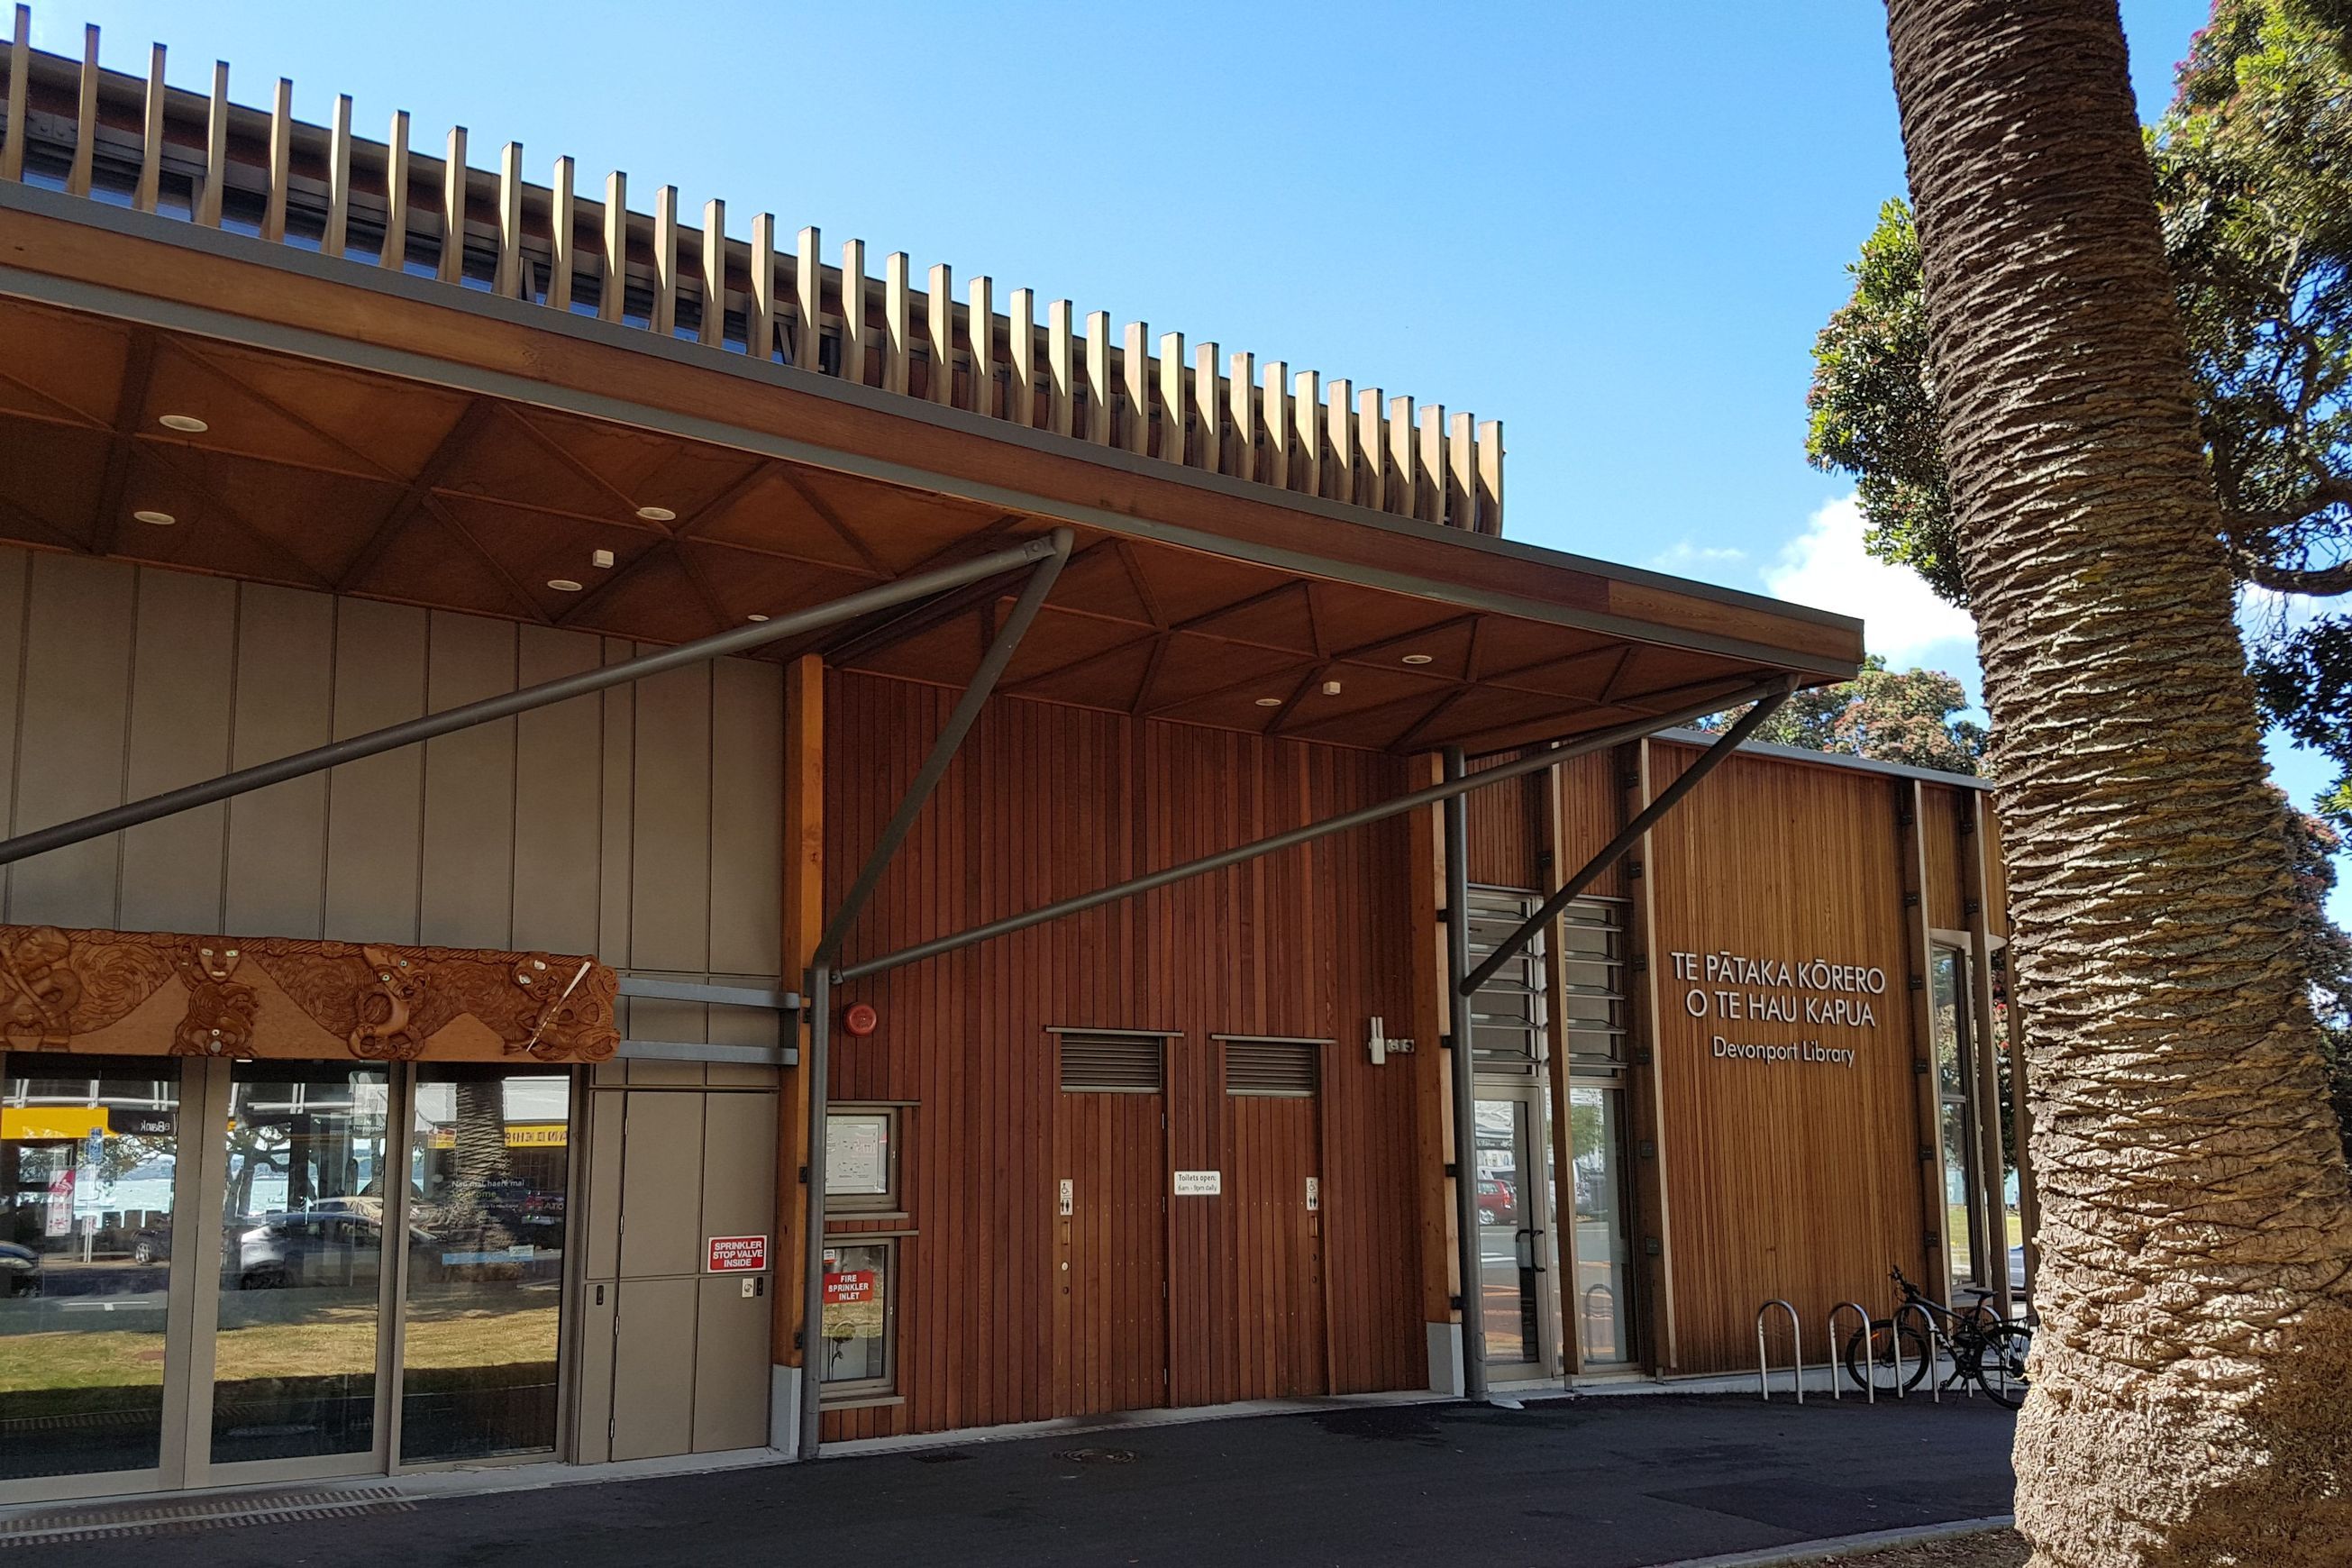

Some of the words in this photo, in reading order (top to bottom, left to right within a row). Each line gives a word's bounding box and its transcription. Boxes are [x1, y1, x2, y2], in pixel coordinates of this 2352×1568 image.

[1671, 952, 1698, 981] TE
[1706, 952, 1792, 988] PĀTAKA
[1798, 959, 1886, 994] KŌRERO
[1686, 989, 1708, 1017] O
[1714, 991, 1741, 1019] TE
[1748, 993, 1797, 1023] HAU
[1805, 997, 1875, 1027] KAPUA
[1713, 1036, 1799, 1064] Devonport
[1802, 1041, 1855, 1067] Library
[715, 1241, 762, 1251] SPRINKLER
[713, 1251, 735, 1260] STOP
[736, 1249, 763, 1258] VALVE
[724, 1258, 752, 1267] INSIDE
[840, 1274, 857, 1283] FIRE
[828, 1282, 869, 1292] SPRINKLER
[838, 1291, 860, 1301] INLET
